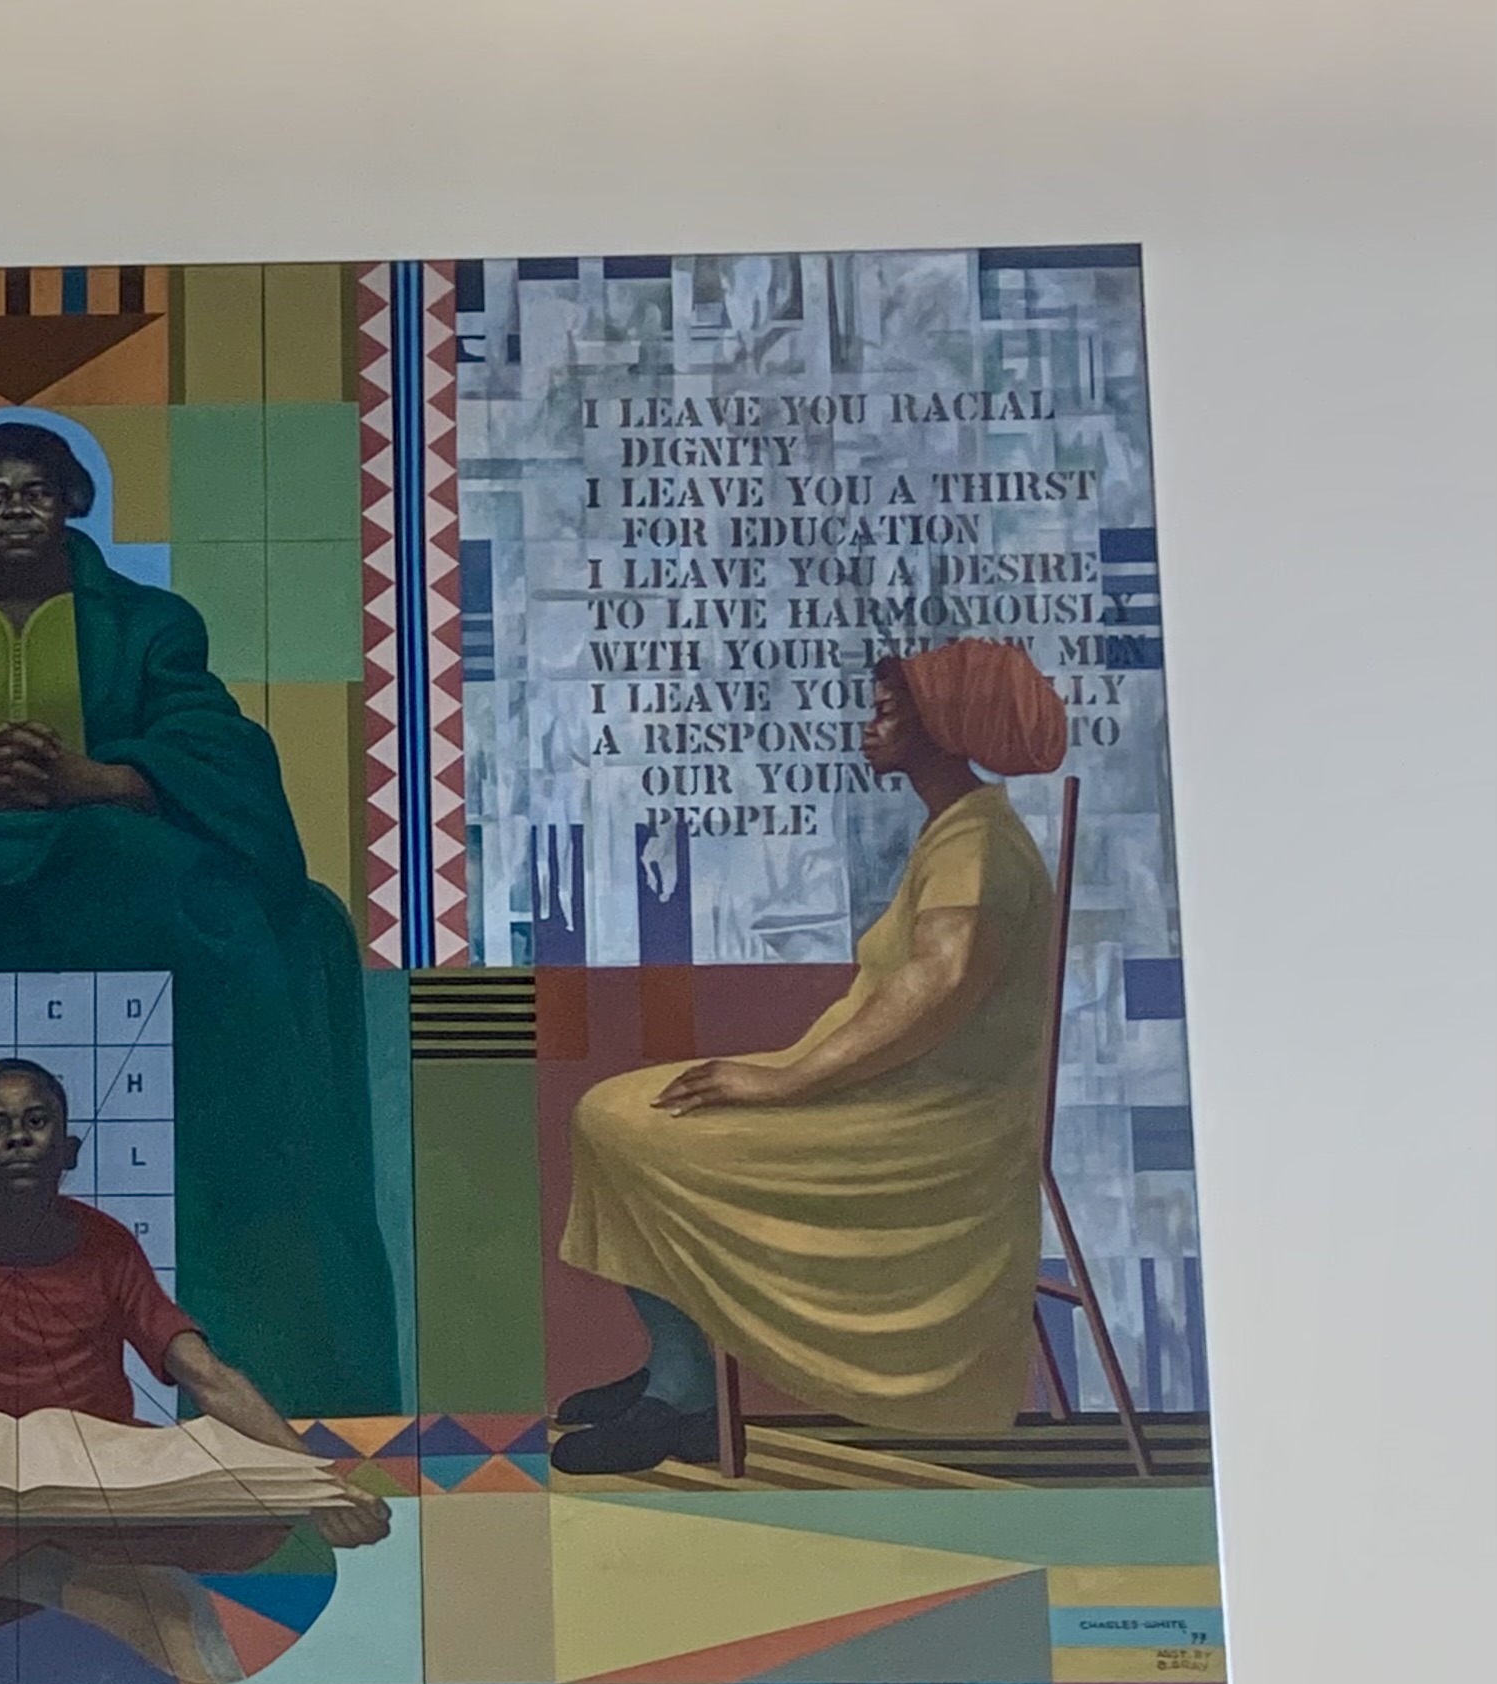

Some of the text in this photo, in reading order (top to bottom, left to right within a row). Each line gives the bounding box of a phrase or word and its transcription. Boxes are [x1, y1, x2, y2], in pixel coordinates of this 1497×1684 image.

[584, 389, 1056, 428] I LEAVE YOU RACIAL
[621, 436, 798, 468] DIGNITY
[585, 469, 1097, 508] I LEAVE YOU A THIRST
[622, 512, 980, 548] FOR EDUCATION
[588, 551, 1099, 589] I LEAVE YOU A DESIRE
[588, 591, 1135, 631] TO LIVE HARMONIOUSLY
[589, 640, 701, 672] WITH
[723, 638, 842, 670] YOUR
[591, 682, 606, 714] I
[627, 680, 771, 714] LEAVE
[592, 723, 621, 756] A
[1069, 716, 1120, 747] TO
[642, 763, 733, 796] OUR
[646, 803, 818, 838] PEOPLE
[47, 1000, 63, 1019] C
[126, 999, 142, 1019] D
[126, 1073, 143, 1093] H
[131, 1147, 146, 1166] L
